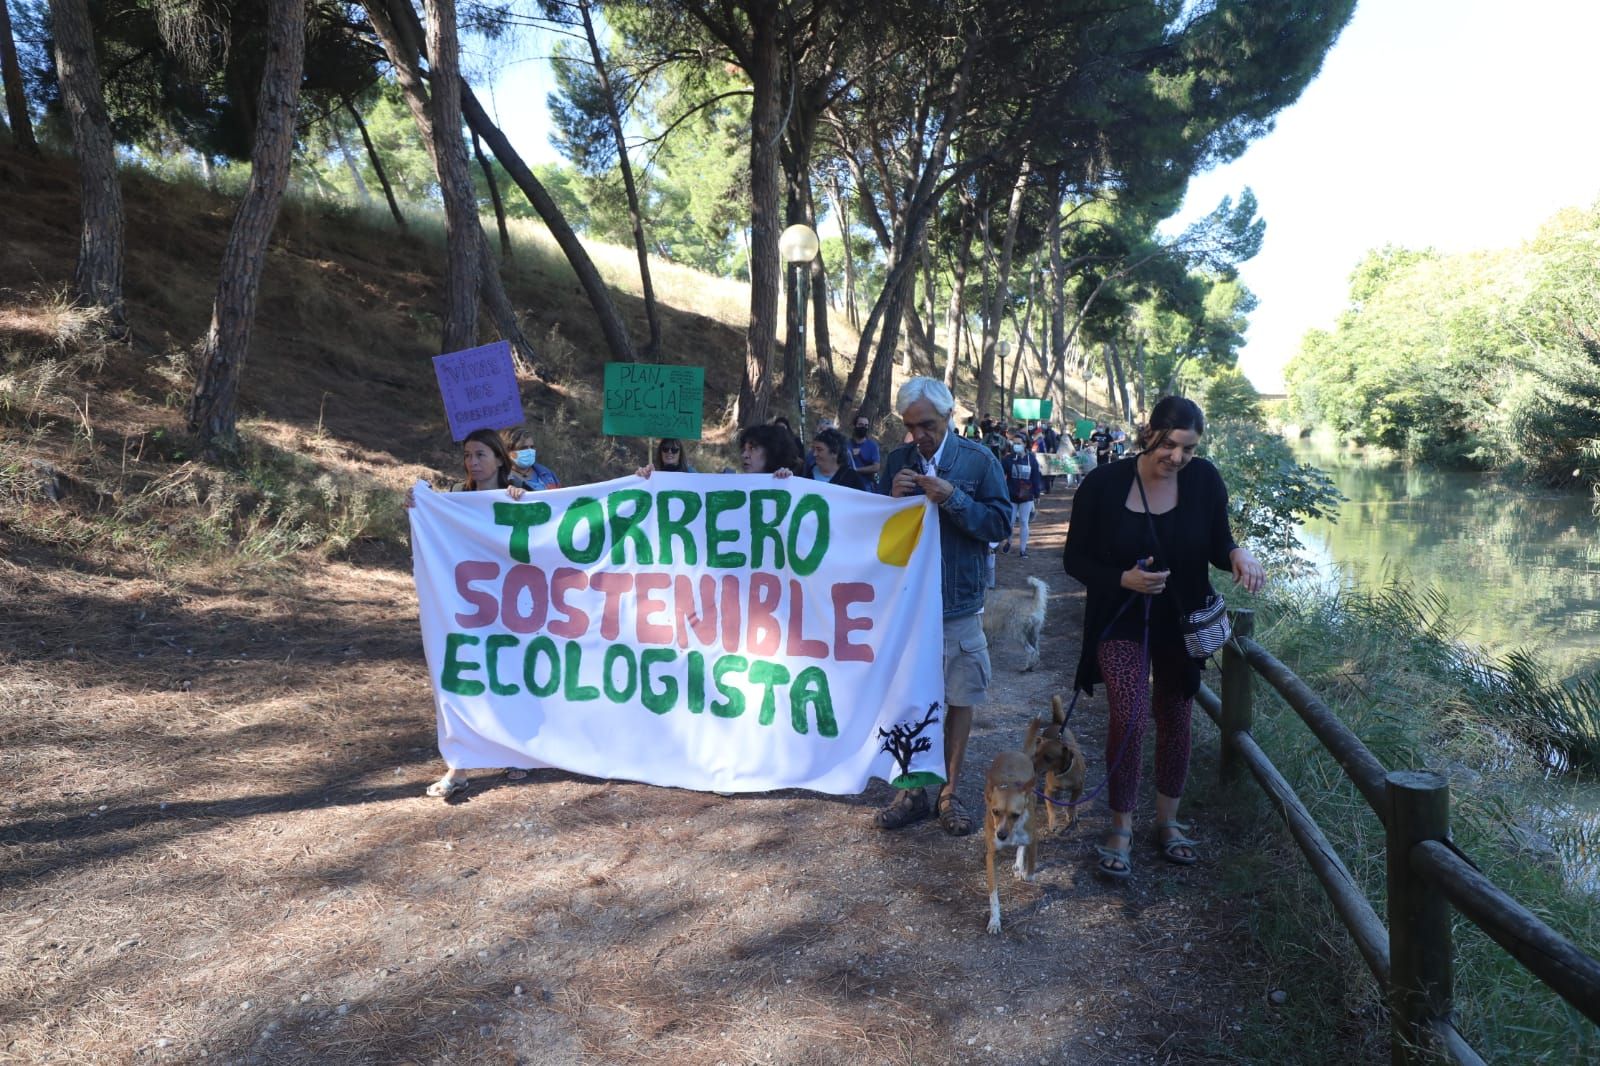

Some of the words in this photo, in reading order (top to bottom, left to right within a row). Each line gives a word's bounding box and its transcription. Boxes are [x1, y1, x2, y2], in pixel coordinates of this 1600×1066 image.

[620, 364, 661, 386] PLAN
[493, 488, 830, 577] TORRERO
[454, 560, 876, 663] SOSTENIBLE
[440, 632, 839, 739] ECOLOGISTA
